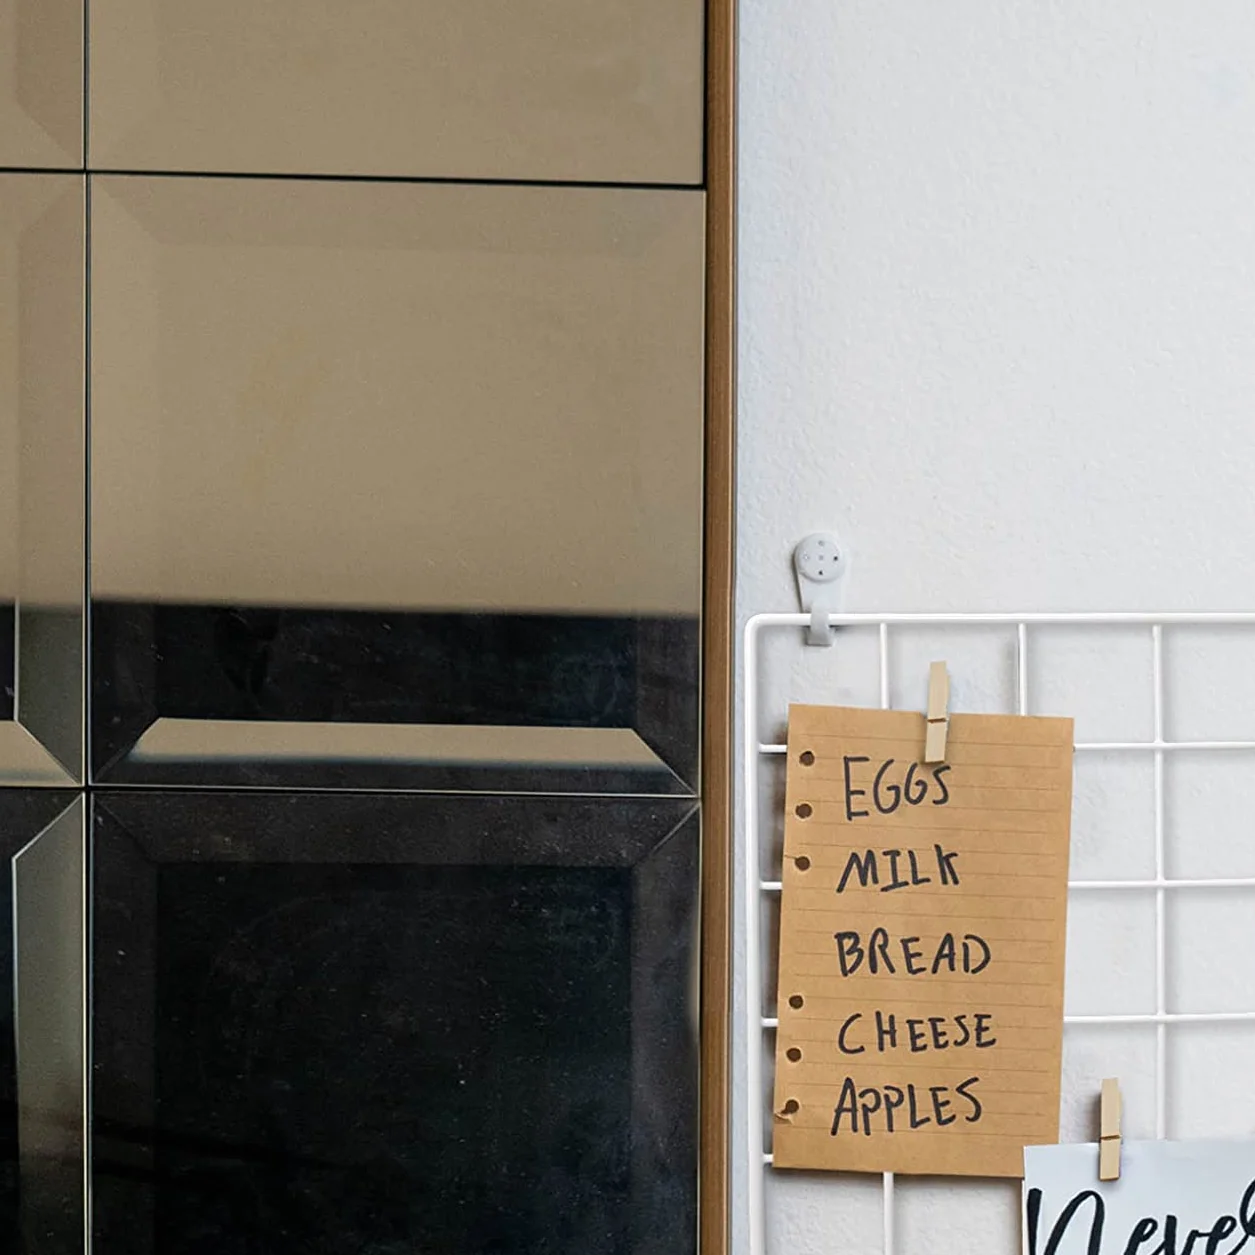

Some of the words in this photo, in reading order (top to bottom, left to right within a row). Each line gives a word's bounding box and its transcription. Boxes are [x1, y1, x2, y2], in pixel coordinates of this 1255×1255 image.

[843, 755, 952, 821] EGGS
[836, 843, 960, 894] MILK
[833, 927, 992, 978] BREAD
[838, 1010, 998, 1055] CHEESE
[830, 1076, 983, 1137] APPLES
